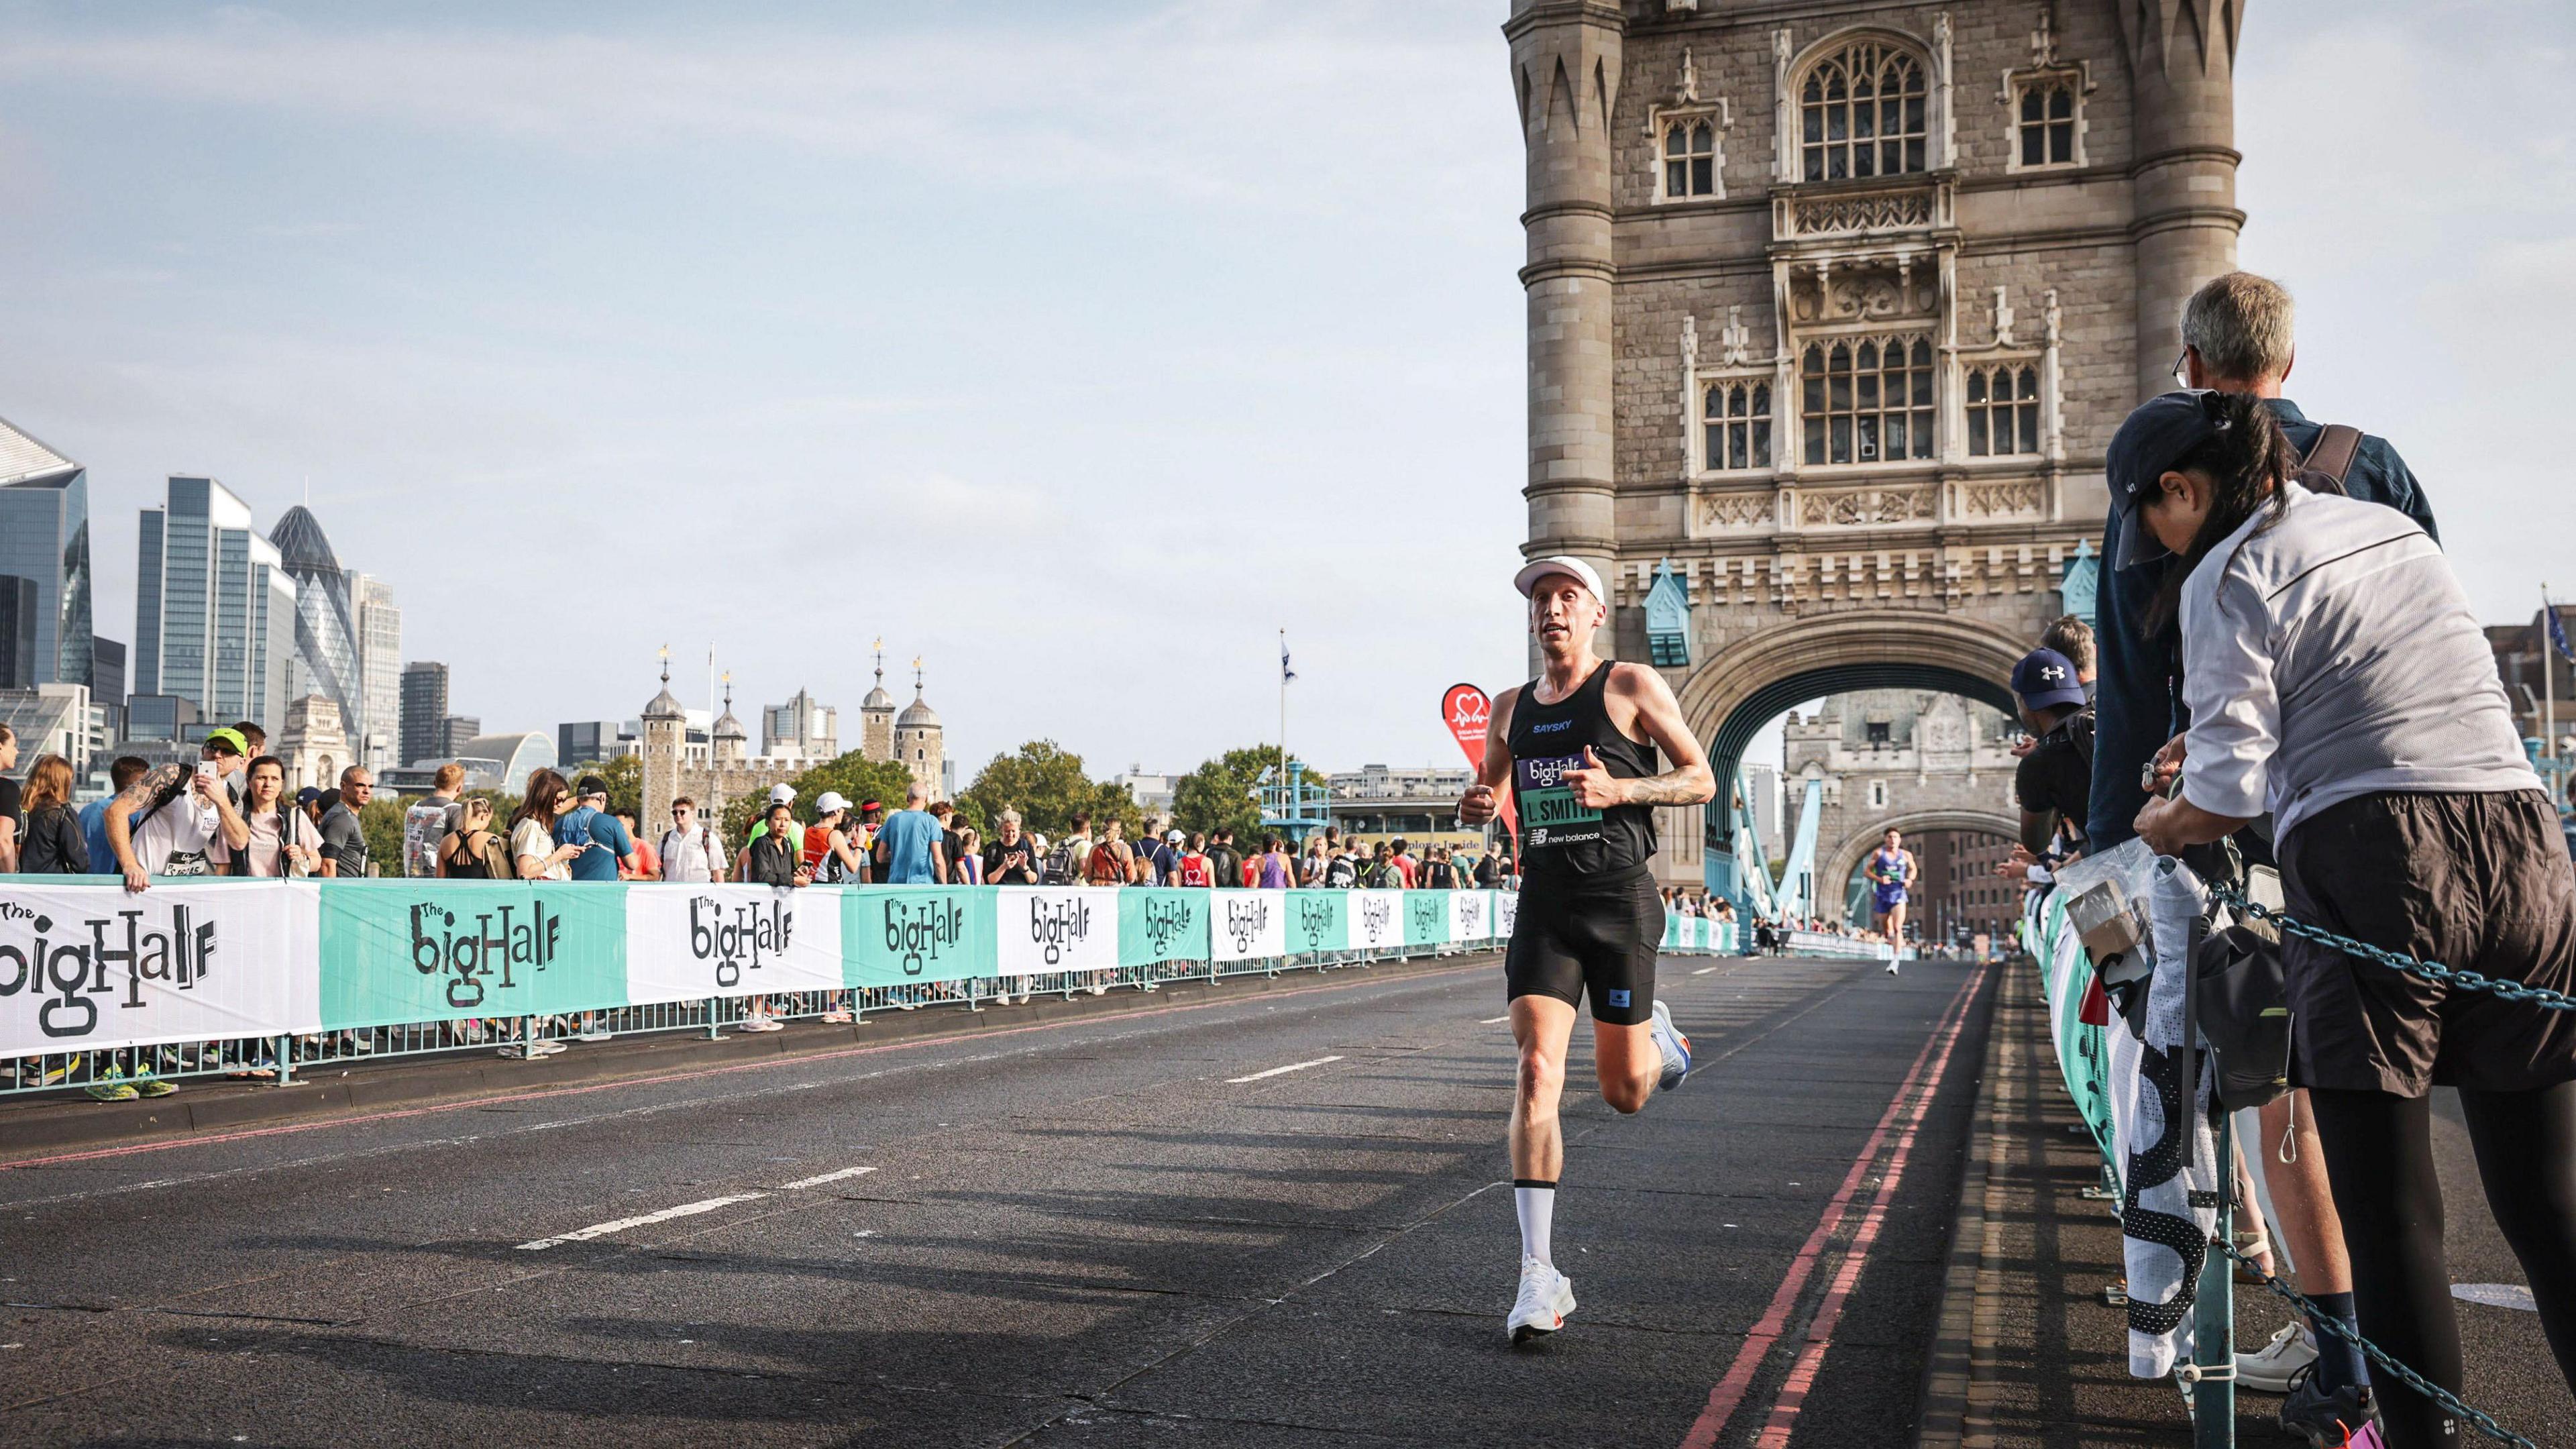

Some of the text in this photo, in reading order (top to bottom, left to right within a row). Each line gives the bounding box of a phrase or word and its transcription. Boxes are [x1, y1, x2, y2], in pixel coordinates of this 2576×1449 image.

[1533, 719, 1572, 733] SAYSKY
[1527, 802, 1538, 822] L.
[1444, 840, 1479, 849] Inide
[1548, 835, 1564, 843] new
[1565, 832, 1600, 842] balance
[698, 895, 714, 909] The
[0, 902, 35, 920] The
[421, 902, 443, 918] The
